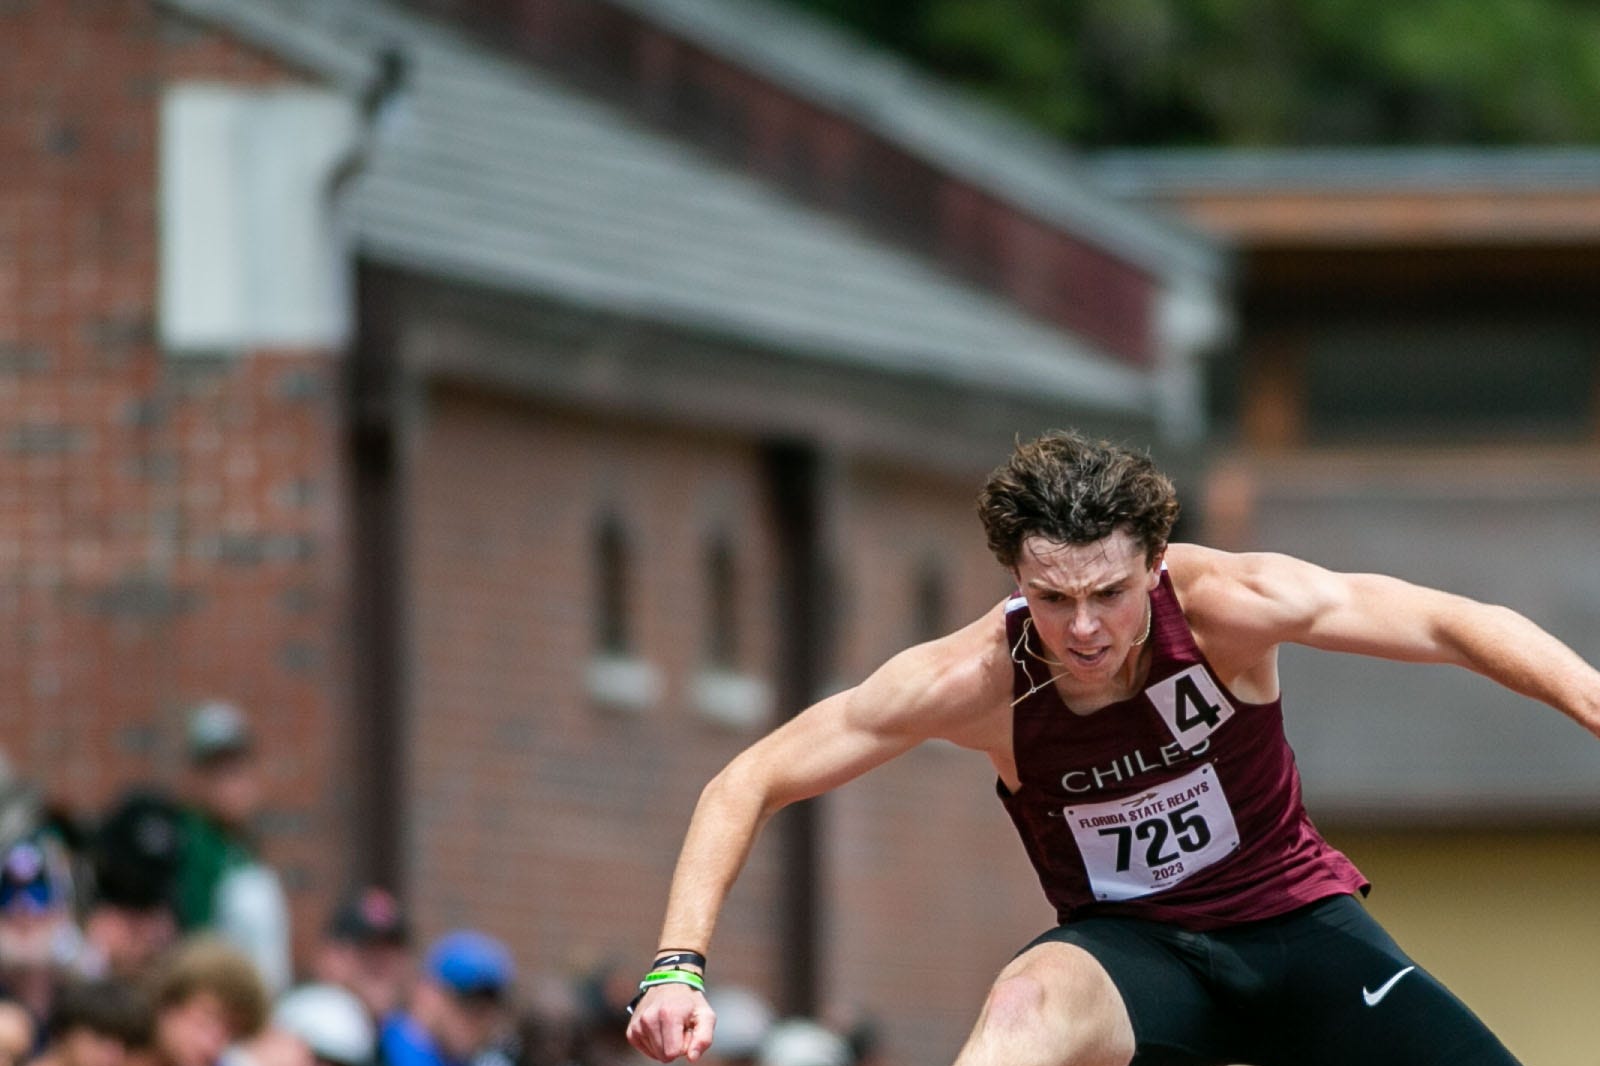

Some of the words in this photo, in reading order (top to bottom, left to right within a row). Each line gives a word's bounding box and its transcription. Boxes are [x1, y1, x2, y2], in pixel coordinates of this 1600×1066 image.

[1175, 673, 1222, 733] 4
[1078, 812, 1127, 829] FLORIDA
[1129, 802, 1166, 822] STATE
[1168, 781, 1210, 809] RELAYS
[1097, 800, 1211, 872] 725
[1152, 861, 1185, 881] 2023
